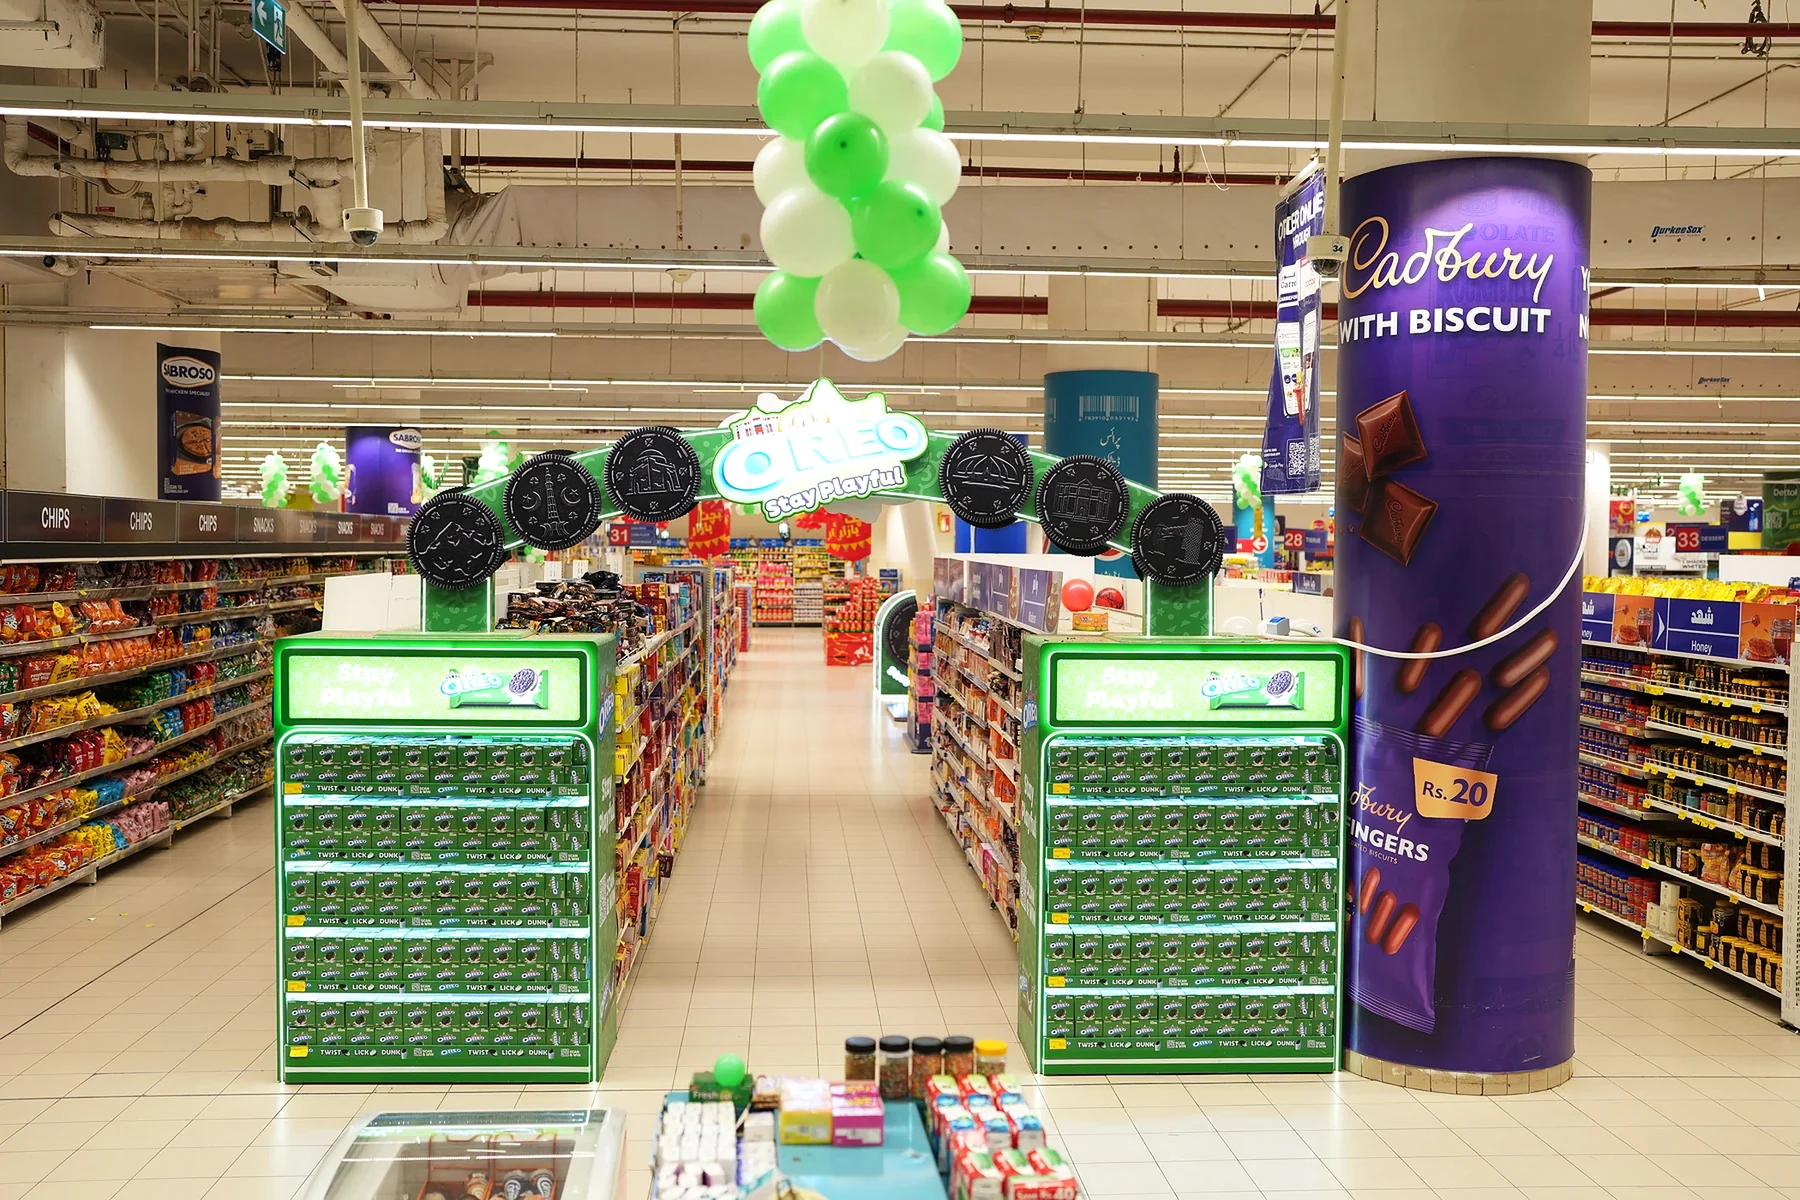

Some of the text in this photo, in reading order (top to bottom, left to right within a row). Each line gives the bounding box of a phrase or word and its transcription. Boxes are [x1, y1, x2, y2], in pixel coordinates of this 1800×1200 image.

[1342, 216, 1554, 303] Cadbury
[1339, 307, 1551, 344] WITH BISCUIT
[721, 416, 924, 494] OREO
[764, 466, 905, 519] Stay Playful
[1773, 488, 1798, 496] Dettol
[42, 506, 70, 529] CHIPS
[130, 512, 152, 531] CHIPS
[199, 514, 218, 532] CHIPS
[253, 517, 274, 533] SNACKS
[300, 519, 316, 534] SNACKS
[338, 521, 353, 534] SNACKS
[370, 522, 384, 536] SNACKS
[610, 528, 628, 542] 31
[1285, 533, 1302, 546] 28
[1678, 532, 1700, 548] 33
[1692, 640, 1712, 656] Honey
[1422, 778, 1488, 807] Rs. 20
[1350, 782, 1412, 834] dbury
[1368, 848, 1398, 864] BISCUITS
